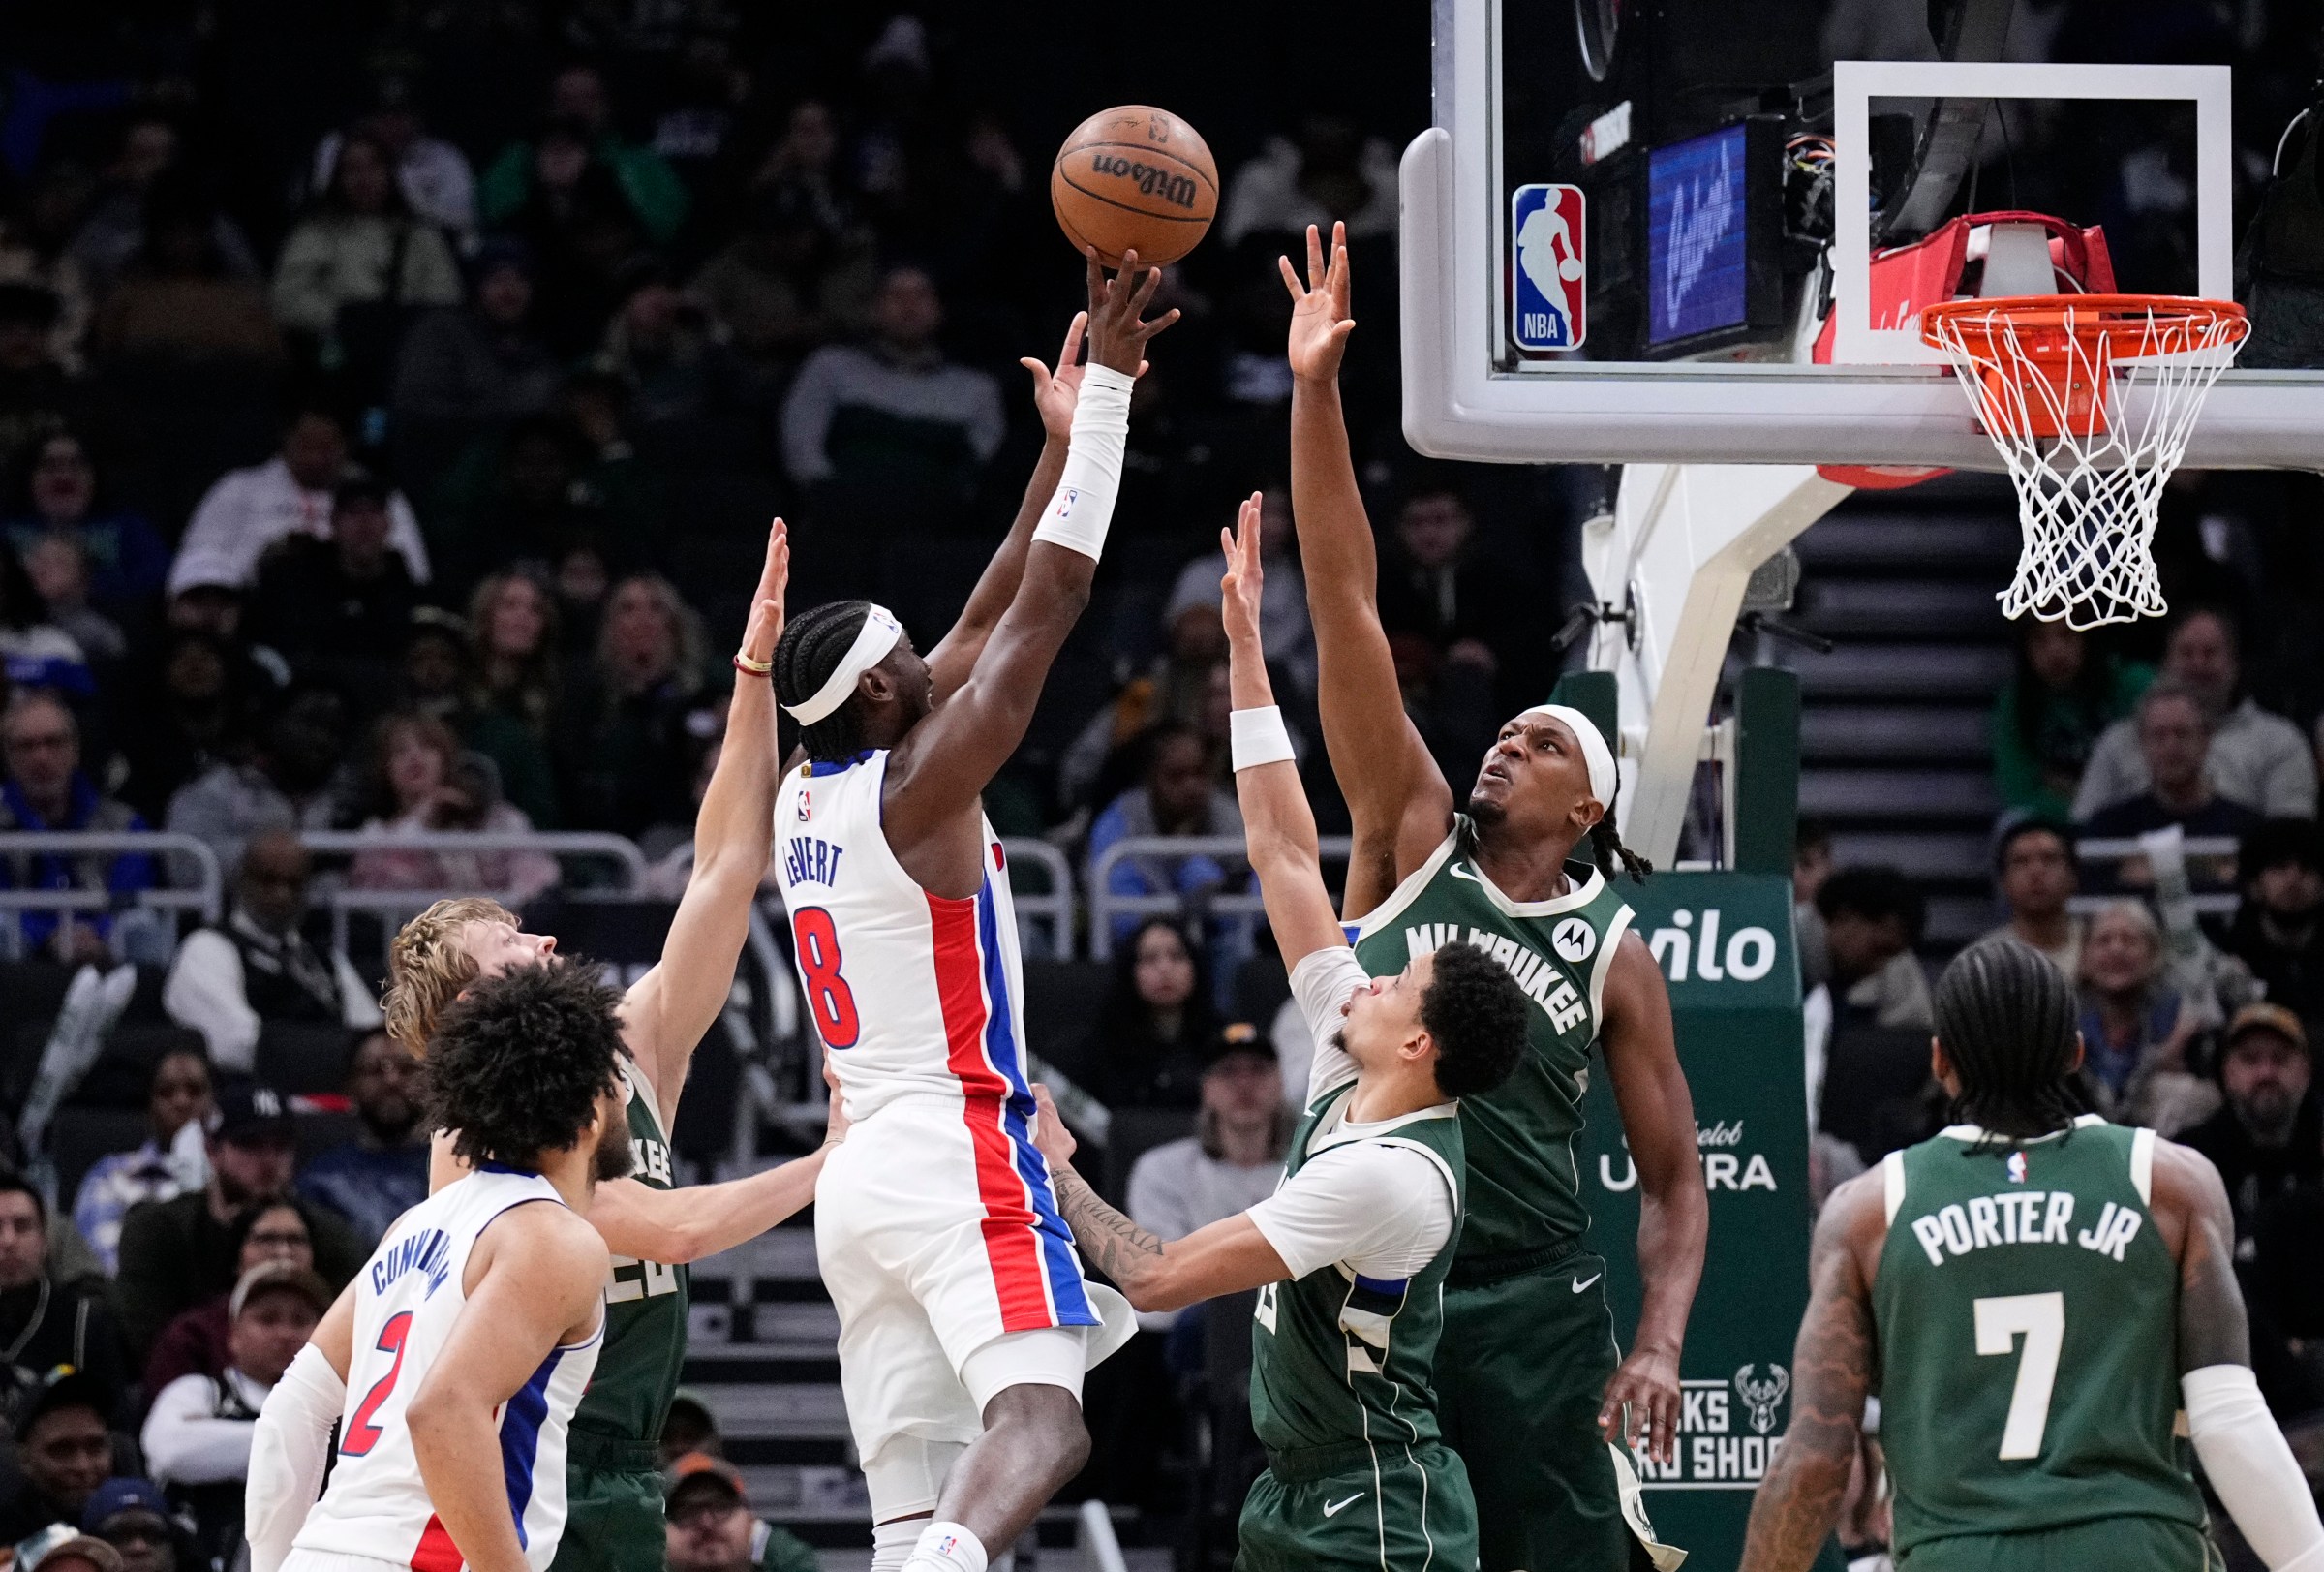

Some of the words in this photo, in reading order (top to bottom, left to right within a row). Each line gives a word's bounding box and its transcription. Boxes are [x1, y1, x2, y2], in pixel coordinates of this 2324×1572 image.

[1092, 153, 1197, 210] Wilson
[1524, 313, 1558, 339] NBA
[793, 906, 860, 1050] 8
[1600, 1154, 1778, 1192] URA
[1911, 1191, 2075, 1267] PORTER
[2077, 1201, 2143, 1262] JR
[339, 1310, 414, 1457] 2
[1973, 1291, 2065, 1461] 7
